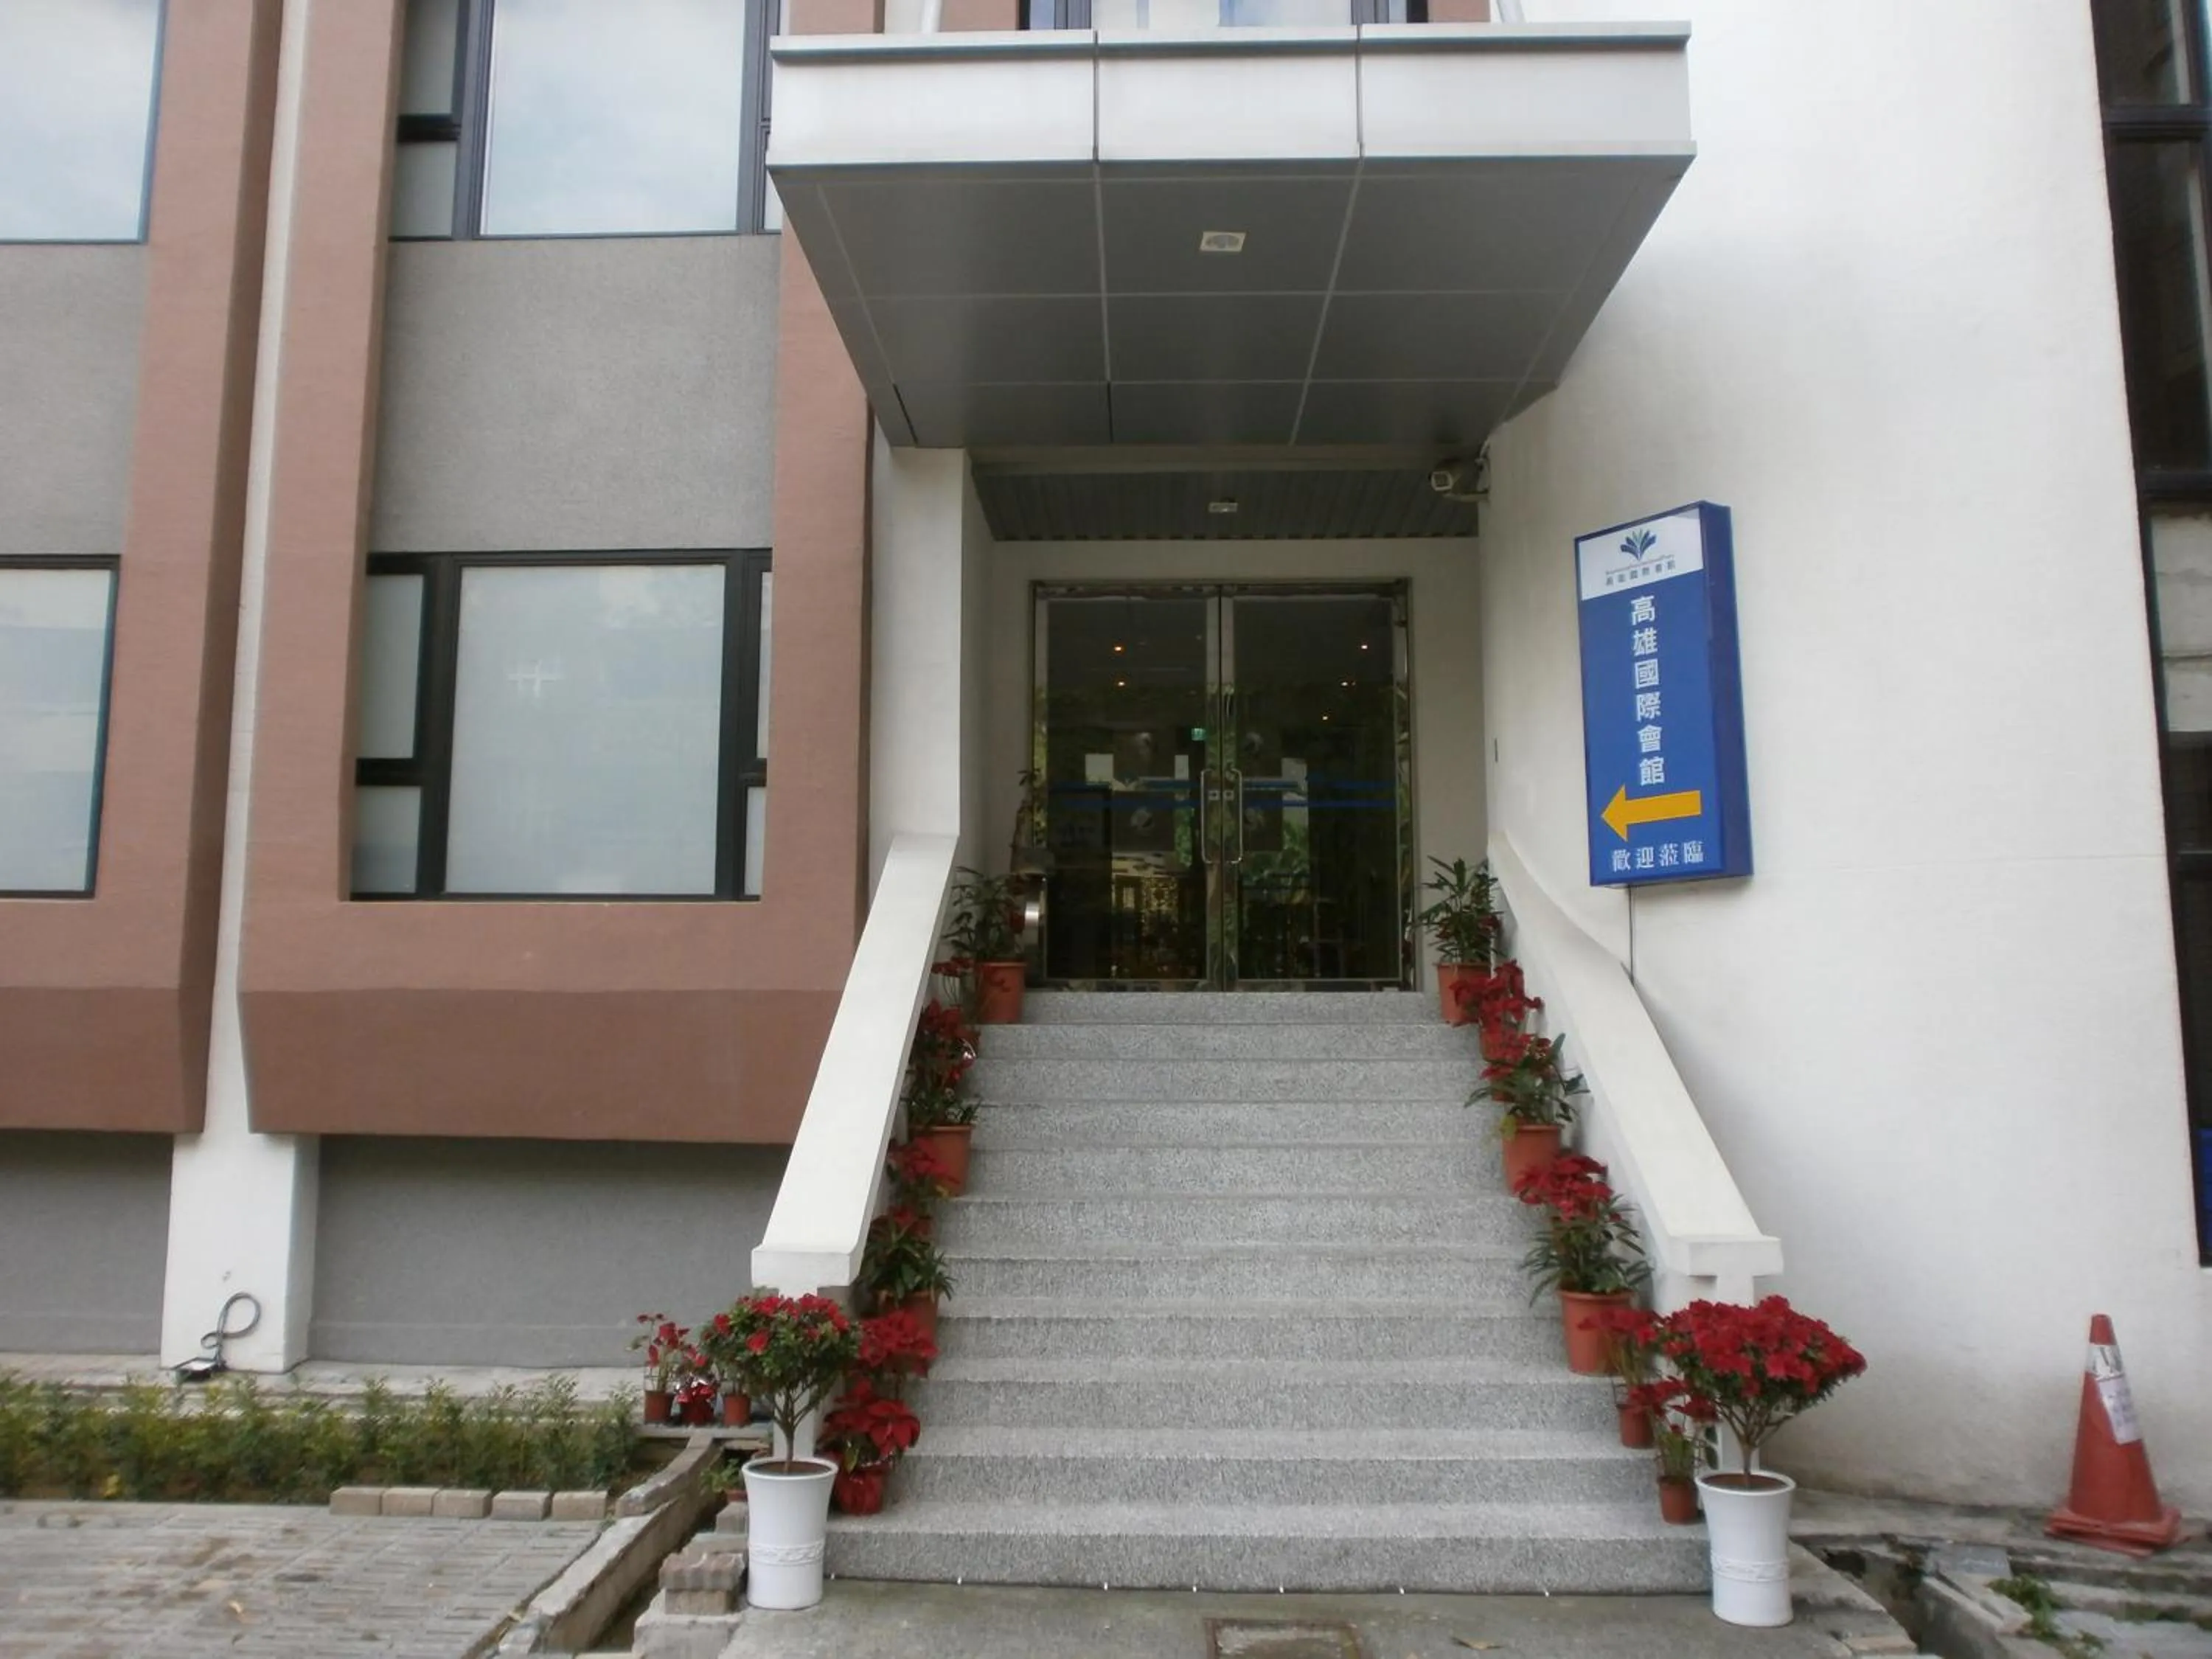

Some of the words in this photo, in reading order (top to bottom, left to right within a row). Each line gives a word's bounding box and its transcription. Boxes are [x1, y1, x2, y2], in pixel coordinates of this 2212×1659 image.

[1630, 595, 1665, 787] 高雄國際會館
[1612, 840, 1703, 872] 歡迎蒞臨
